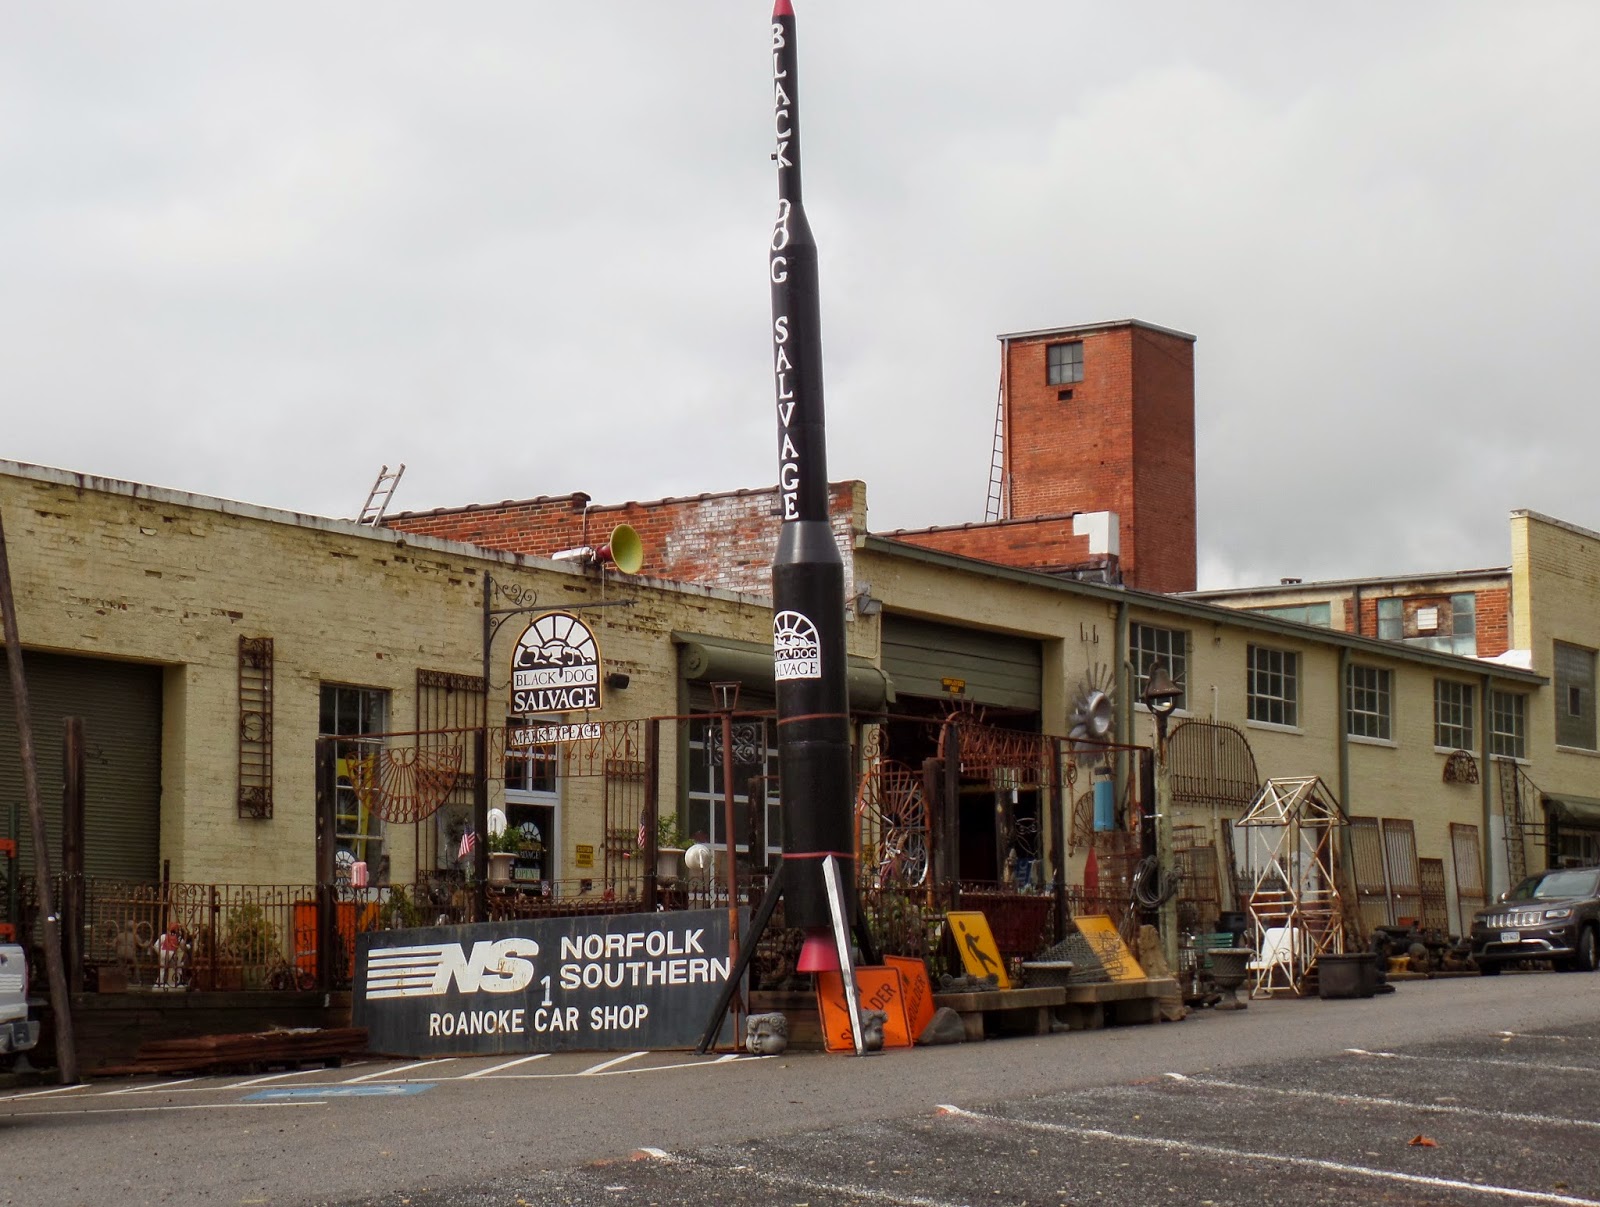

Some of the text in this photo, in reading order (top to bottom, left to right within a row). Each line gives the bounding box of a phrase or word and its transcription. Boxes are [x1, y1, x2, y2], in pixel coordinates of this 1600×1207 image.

[771, 23, 792, 169] BLACK
[775, 316, 799, 521] SALVAGE
[793, 648, 817, 659] DOG
[516, 668, 595, 686] BLACK DOG
[513, 687, 596, 712] SALVAGE
[560, 928, 705, 961] NORFOLK
[430, 938, 540, 994] NS
[559, 956, 732, 990] SOUTHERN
[540, 975, 553, 1007] 1
[428, 1003, 649, 1037] ROANOKE CAR SHOP
